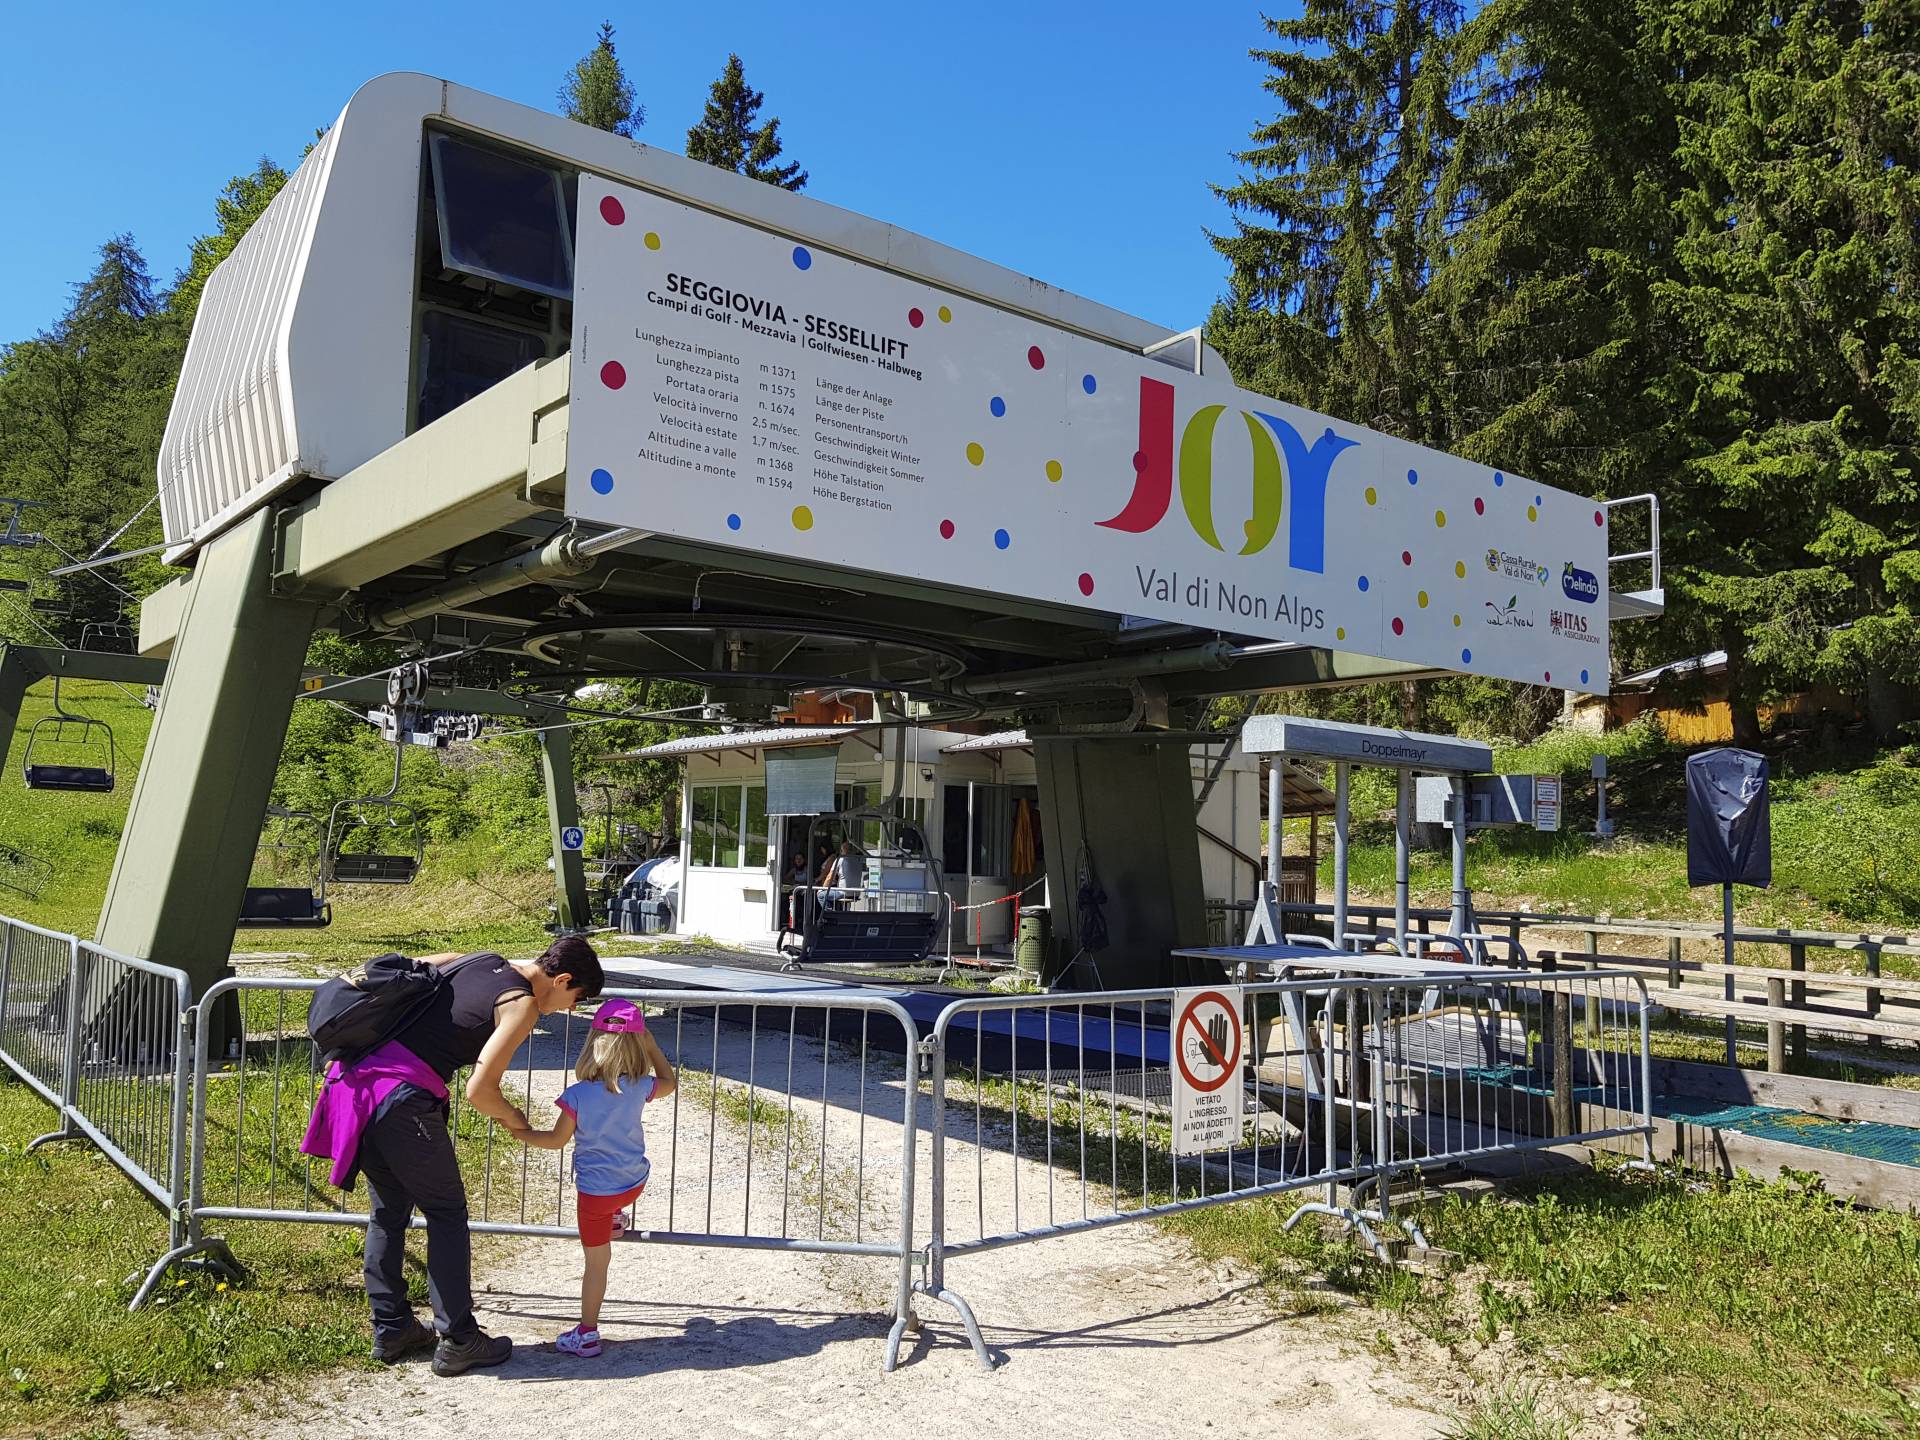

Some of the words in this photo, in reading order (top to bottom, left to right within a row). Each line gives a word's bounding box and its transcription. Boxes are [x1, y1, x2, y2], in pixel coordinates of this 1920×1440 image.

[666, 272, 787, 325] SEGGIOVIA
[804, 314, 909, 360] SESSELLIFT
[635, 327, 692, 353] Lunghezza
[694, 344, 740, 366] impianto
[647, 291, 688, 312] Campi
[690, 304, 702, 316] di
[705, 308, 732, 325] Golf
[741, 318, 797, 343] Mezzavia
[807, 337, 869, 364] Golfwiesen
[877, 357, 923, 381] Halbweg
[656, 353, 712, 377] Lunghezza
[714, 370, 739, 384] pista
[760, 364, 769, 373] m
[772, 365, 796, 381] 1371
[666, 375, 706, 395] Portata
[708, 388, 739, 403] oraria
[759, 383, 768, 392] m
[771, 383, 796, 399] 1575
[816, 376, 844, 394] Länge
[845, 386, 860, 397] der
[862, 390, 893, 407] Anlage
[653, 391, 697, 412] Velocità
[699, 403, 738, 422] inverno
[759, 401, 768, 410] n.
[771, 402, 795, 417] 1674
[815, 395, 843, 412] Länge
[844, 403, 860, 415] der
[862, 407, 885, 421] Piste
[659, 412, 703, 433] Velocità
[705, 426, 738, 441] estate
[752, 416, 768, 429] 2,5
[770, 423, 801, 437] m/sec.
[815, 413, 909, 445] Personentransport/h
[648, 430, 702, 452] Altitudine
[704, 445, 710, 453] a
[712, 446, 737, 460] valle
[752, 435, 767, 448] 1,7
[769, 441, 800, 456] m/sec.
[814, 431, 889, 456] Geschwindigkeit
[890, 449, 921, 465] Winter
[638, 448, 693, 469] Altitudine
[695, 462, 701, 471] a
[703, 464, 736, 479] monte
[757, 457, 766, 467] m
[769, 457, 793, 472] 1368
[813, 450, 888, 474] Geschwindigkeit
[889, 467, 925, 483] Sommer
[1094, 376, 1361, 575] JOY
[756, 476, 765, 485] m
[768, 476, 793, 491] 1594
[813, 467, 839, 482] Höhe
[840, 473, 884, 493] Talstation
[812, 485, 838, 500] Höhe
[839, 491, 893, 512] Bergstation
[1500, 552, 1518, 566] Cassa
[1518, 556, 1537, 570] Rurale
[1503, 564, 1513, 577] Val
[1513, 567, 1520, 578] di
[1520, 569, 1535, 582] Non
[1563, 575, 1597, 595] Melinda
[1135, 565, 1177, 603] Val
[1186, 576, 1209, 609] di
[1217, 581, 1268, 620] Non
[1274, 594, 1325, 633] Alps
[1564, 612, 1588, 633] ITAS
[1362, 740, 1427, 762] Doppelmayr
[1189, 1105, 1228, 1119] L'INGRESSO
[1195, 1094, 1222, 1105] VIETATO
[1183, 1122, 1190, 1132] AI
[1190, 1120, 1205, 1131] NON
[1206, 1116, 1233, 1129] ADDETTI
[1192, 1133, 1200, 1142] AI
[1200, 1130, 1224, 1141] LAVORI
